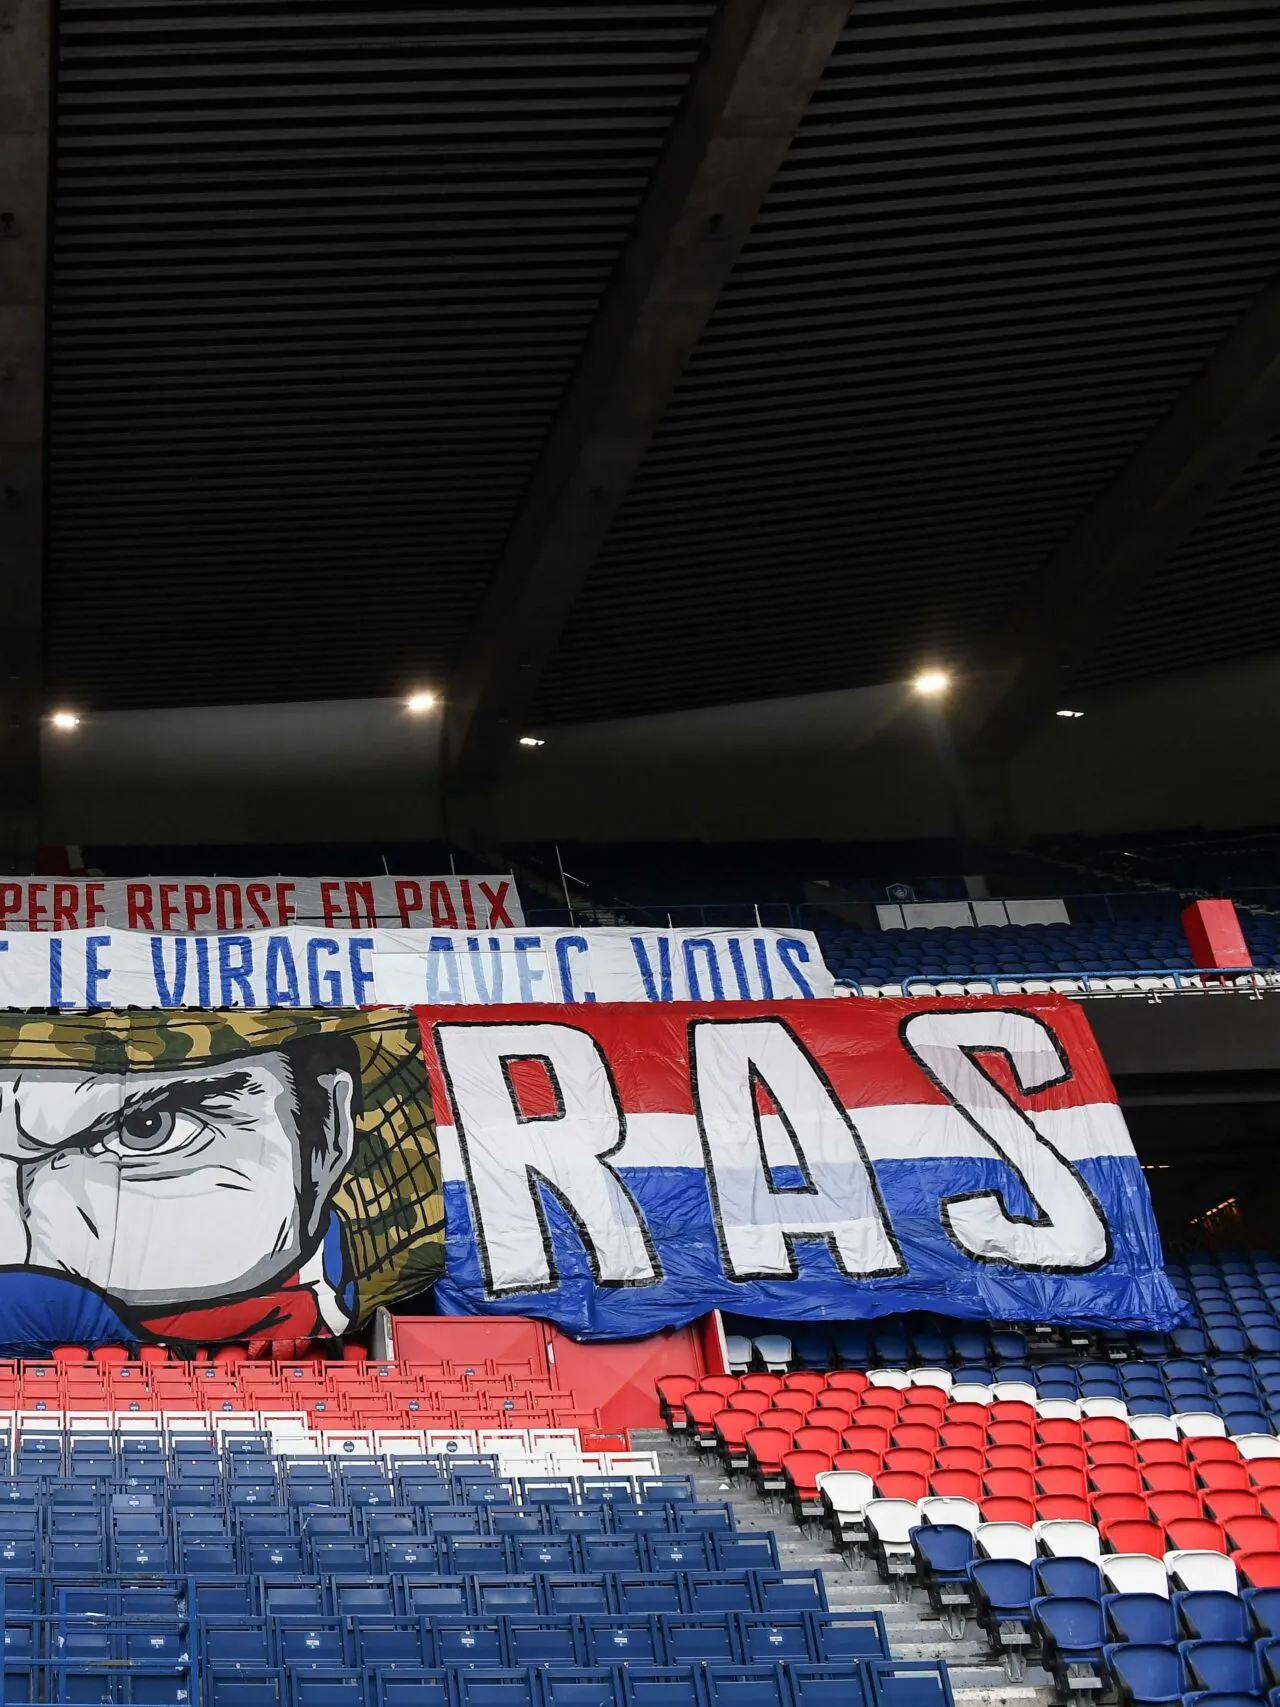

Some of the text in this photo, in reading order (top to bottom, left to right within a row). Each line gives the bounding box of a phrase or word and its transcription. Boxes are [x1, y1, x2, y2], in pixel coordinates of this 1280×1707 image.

[126, 883, 297, 932] REPOSE
[320, 880, 378, 930] EN
[394, 879, 516, 930] PAIX
[49, 935, 112, 1008] LE
[149, 935, 376, 1007] VIRAGE
[426, 935, 597, 1005] AVEC
[629, 936, 816, 1002] VOUS
